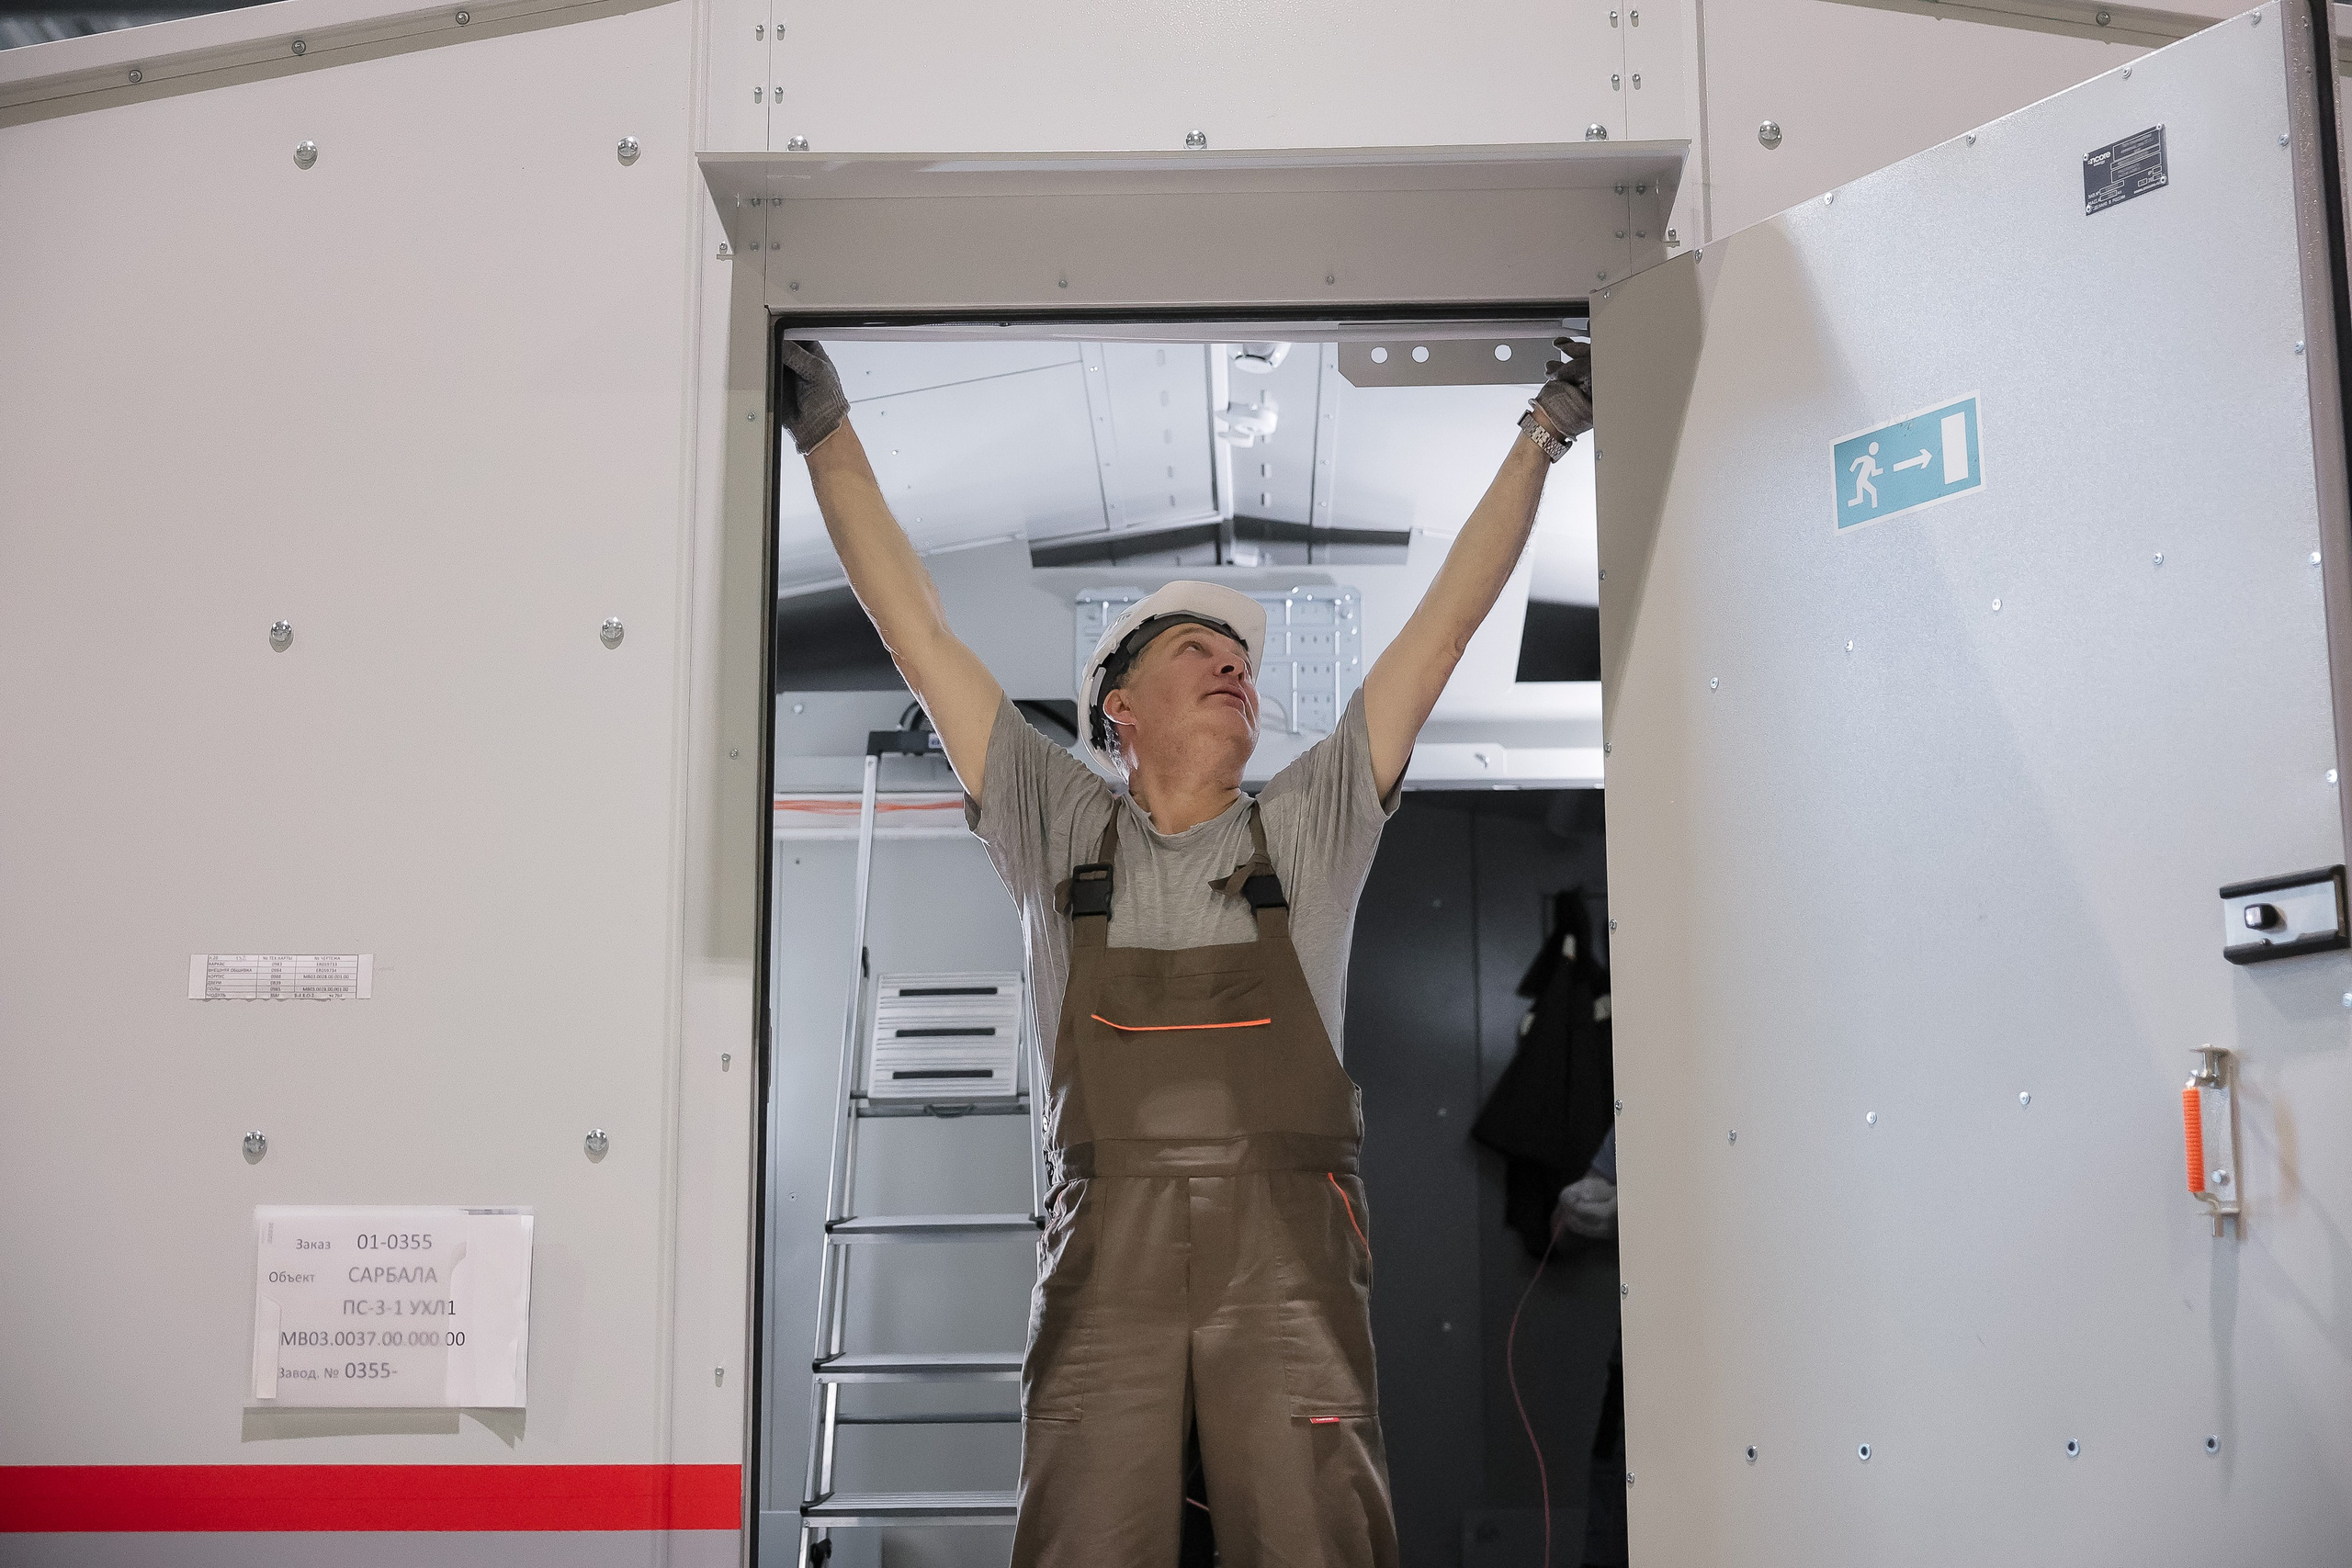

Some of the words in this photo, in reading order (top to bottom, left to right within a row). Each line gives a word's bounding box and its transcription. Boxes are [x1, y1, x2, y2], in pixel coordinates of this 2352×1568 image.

[295, 1238, 331, 1250] Заказ
[356, 1234, 433, 1249] 01-0355
[268, 1271, 315, 1283] Объект
[348, 1267, 437, 1283] САРБАЛА
[343, 1300, 402, 1315] ПС-3-1
[277, 1367, 320, 1380] Завод.
[323, 1367, 339, 1379] №
[345, 1362, 398, 1379] 0355-
